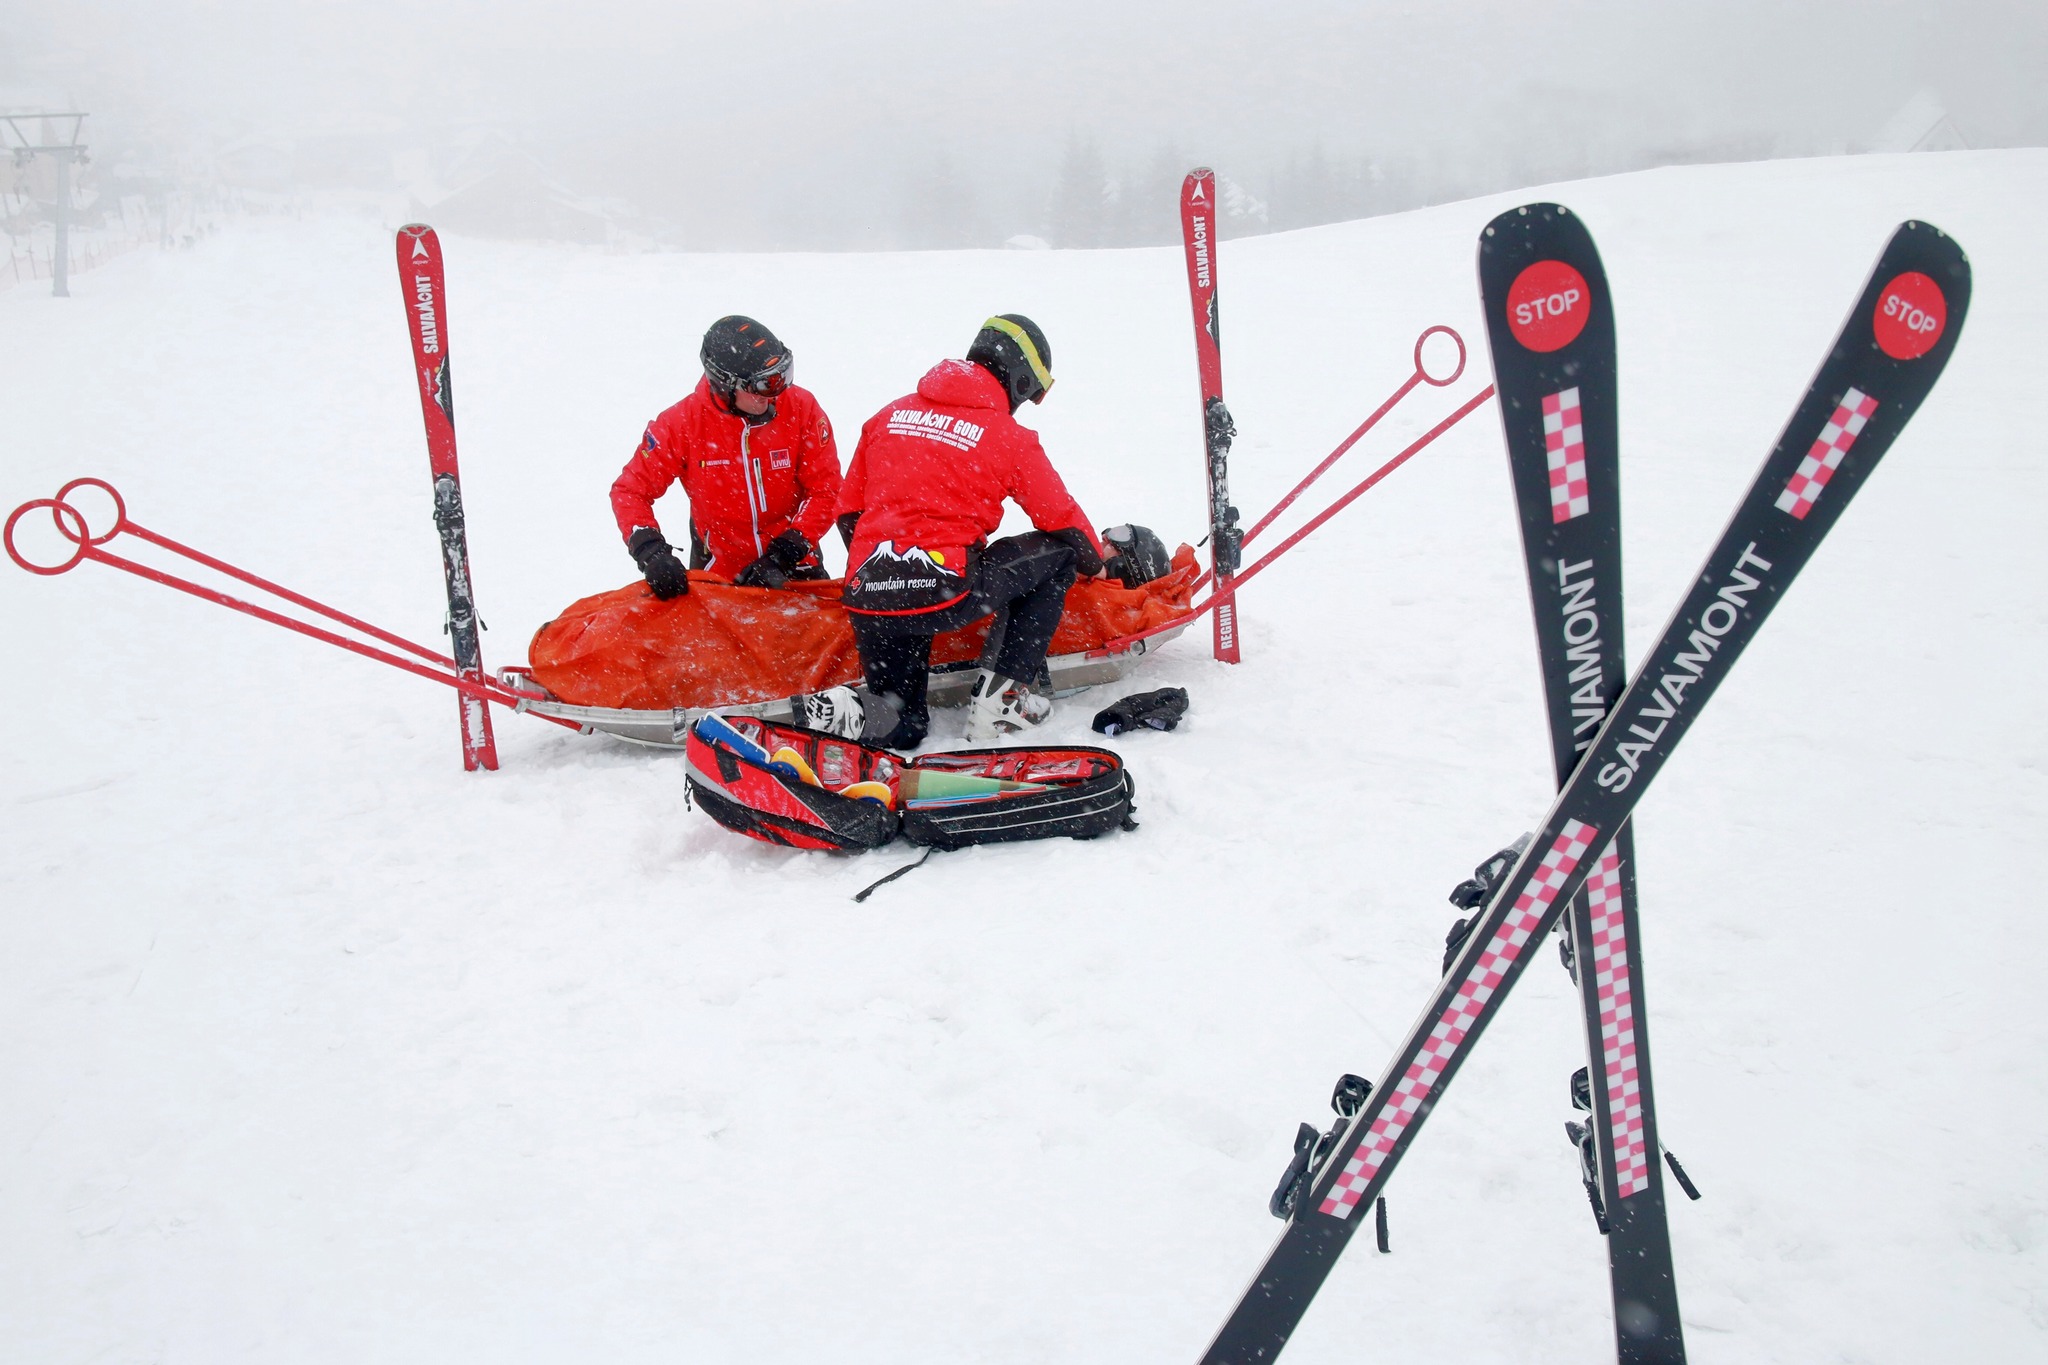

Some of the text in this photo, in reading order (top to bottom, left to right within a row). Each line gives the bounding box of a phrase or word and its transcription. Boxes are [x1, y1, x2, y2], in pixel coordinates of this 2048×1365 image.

[1191, 216, 1210, 288] SALVAMONT
[413, 275, 439, 354] SALVAMONT
[1516, 288, 1580, 325] STOP
[1883, 294, 1937, 334] STOP
[890, 409, 984, 442] SALVAMONT GORJ
[865, 576, 937, 592] mountain rescue
[1219, 604, 1233, 650] REGHIN
[1558, 558, 1606, 751] VAMONT
[1597, 541, 1773, 793] SALVAMONT
